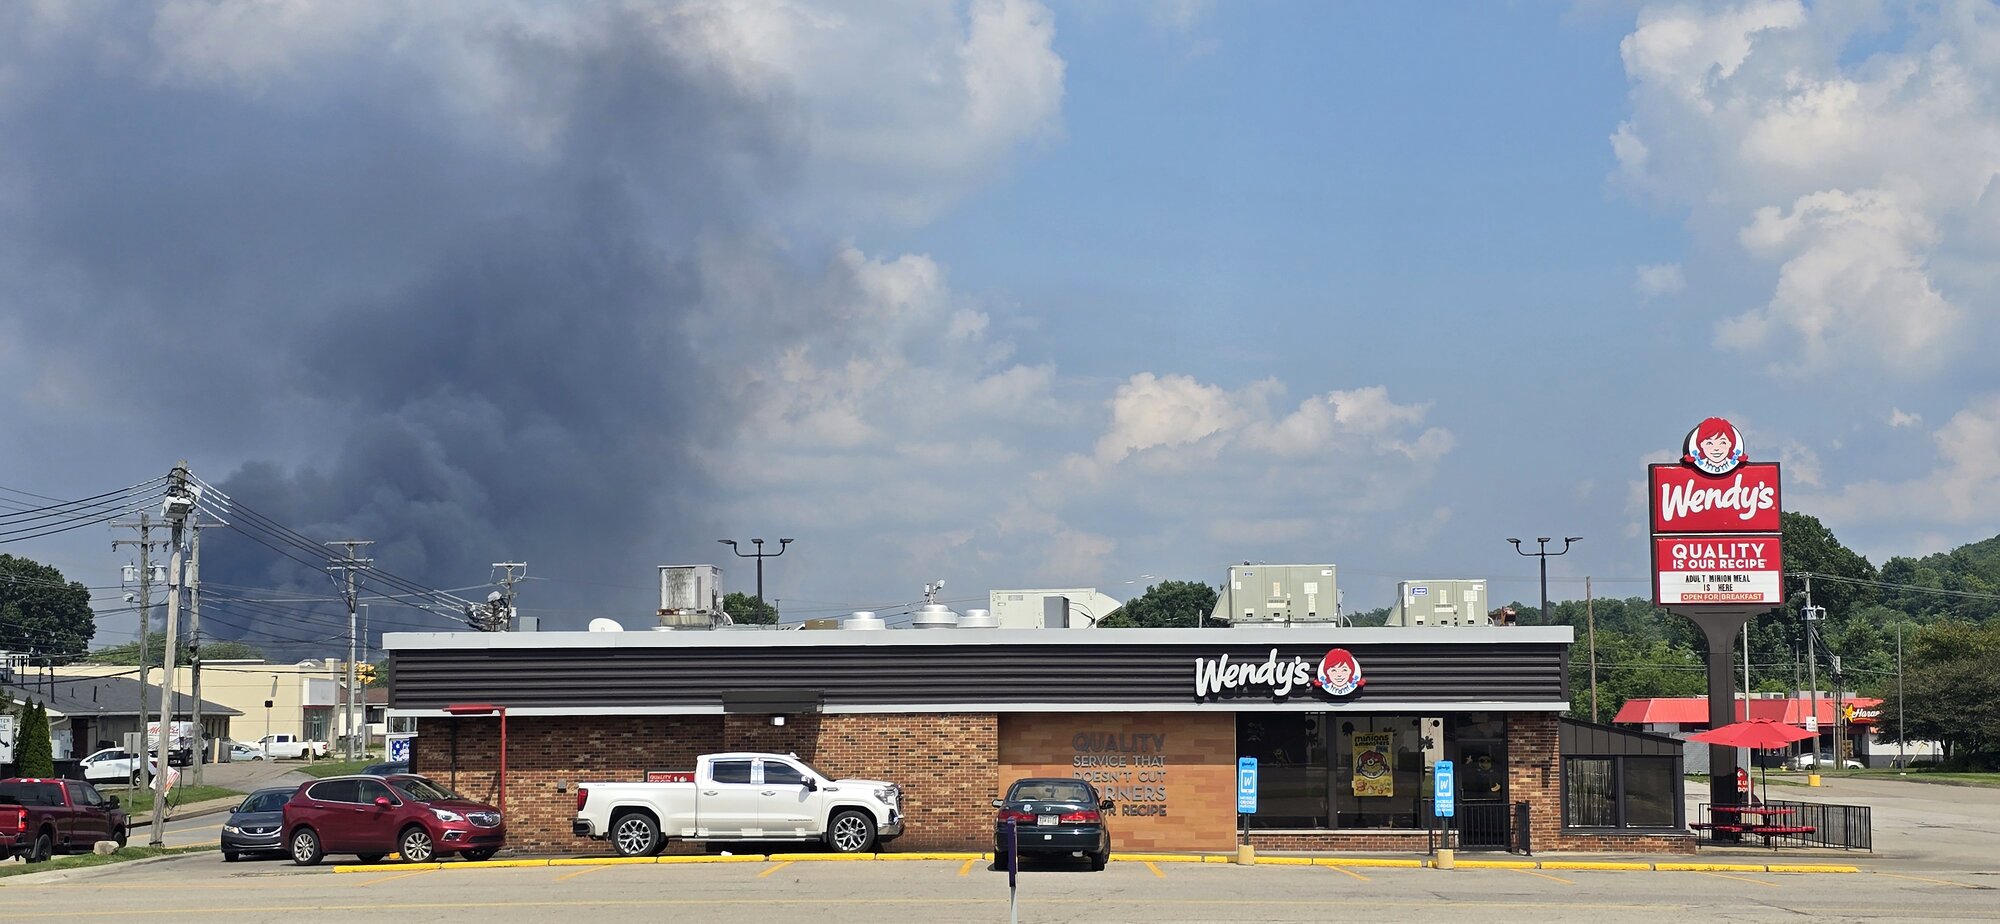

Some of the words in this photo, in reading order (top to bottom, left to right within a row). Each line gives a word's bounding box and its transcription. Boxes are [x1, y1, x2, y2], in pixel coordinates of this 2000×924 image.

[1661, 473, 1775, 521] Wendy's
[1672, 543, 1765, 560] QUALITY
[1672, 560, 1685, 569] IS
[1688, 560, 1716, 569] OUR
[1720, 560, 1767, 569] RECIPE
[1709, 575, 1732, 583] MINION
[1733, 575, 1751, 583] MEAL
[1195, 648, 1311, 697] Wendy's
[1072, 732, 1166, 753] QUALITY
[1354, 734, 1389, 742] minions
[1073, 755, 1127, 768] SERVICE
[1133, 755, 1166, 768] THAT
[1073, 770, 1132, 783] DOESN'T
[1138, 770, 1166, 783] CUT
[1122, 804, 1167, 817] RECIPE
